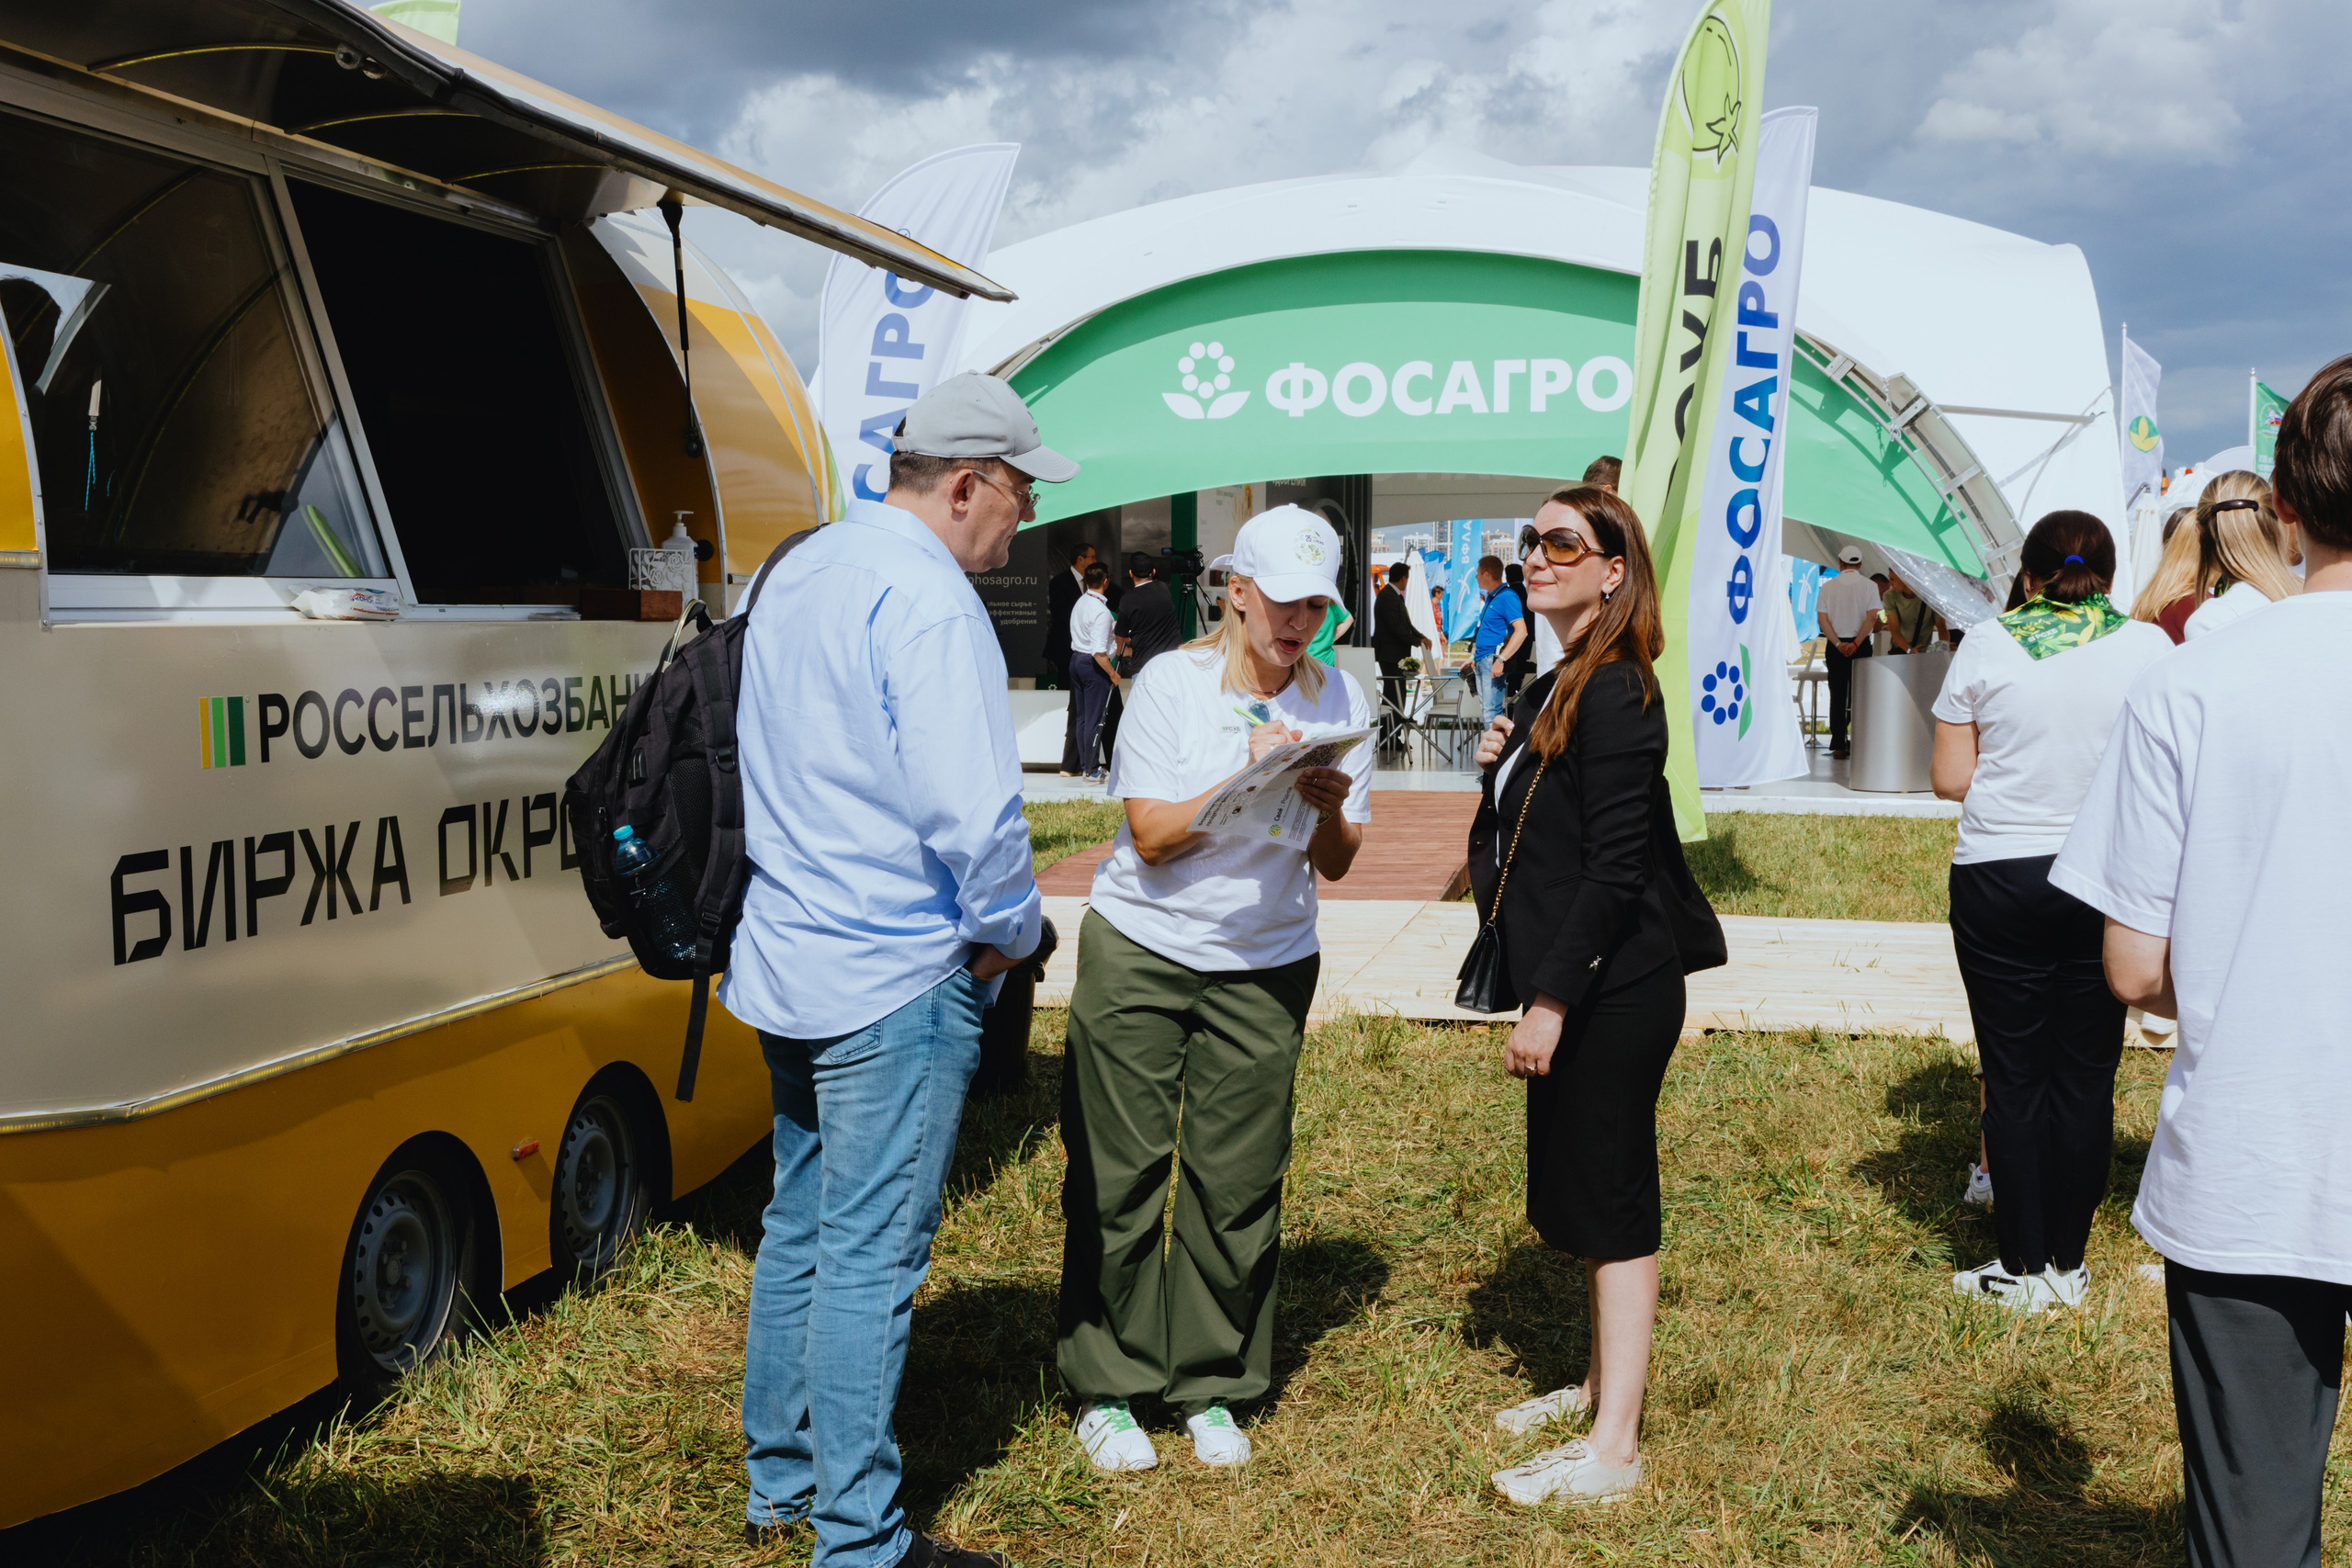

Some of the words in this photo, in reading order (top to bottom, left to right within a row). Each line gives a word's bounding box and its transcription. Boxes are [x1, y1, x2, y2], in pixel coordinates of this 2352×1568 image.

[1265, 355, 1634, 418] ФОСАГРО
[1726, 213, 1781, 626] ФОСАГРО
[1000, 617, 1037, 626] удобрения
[110, 816, 412, 966] БИРЖА
